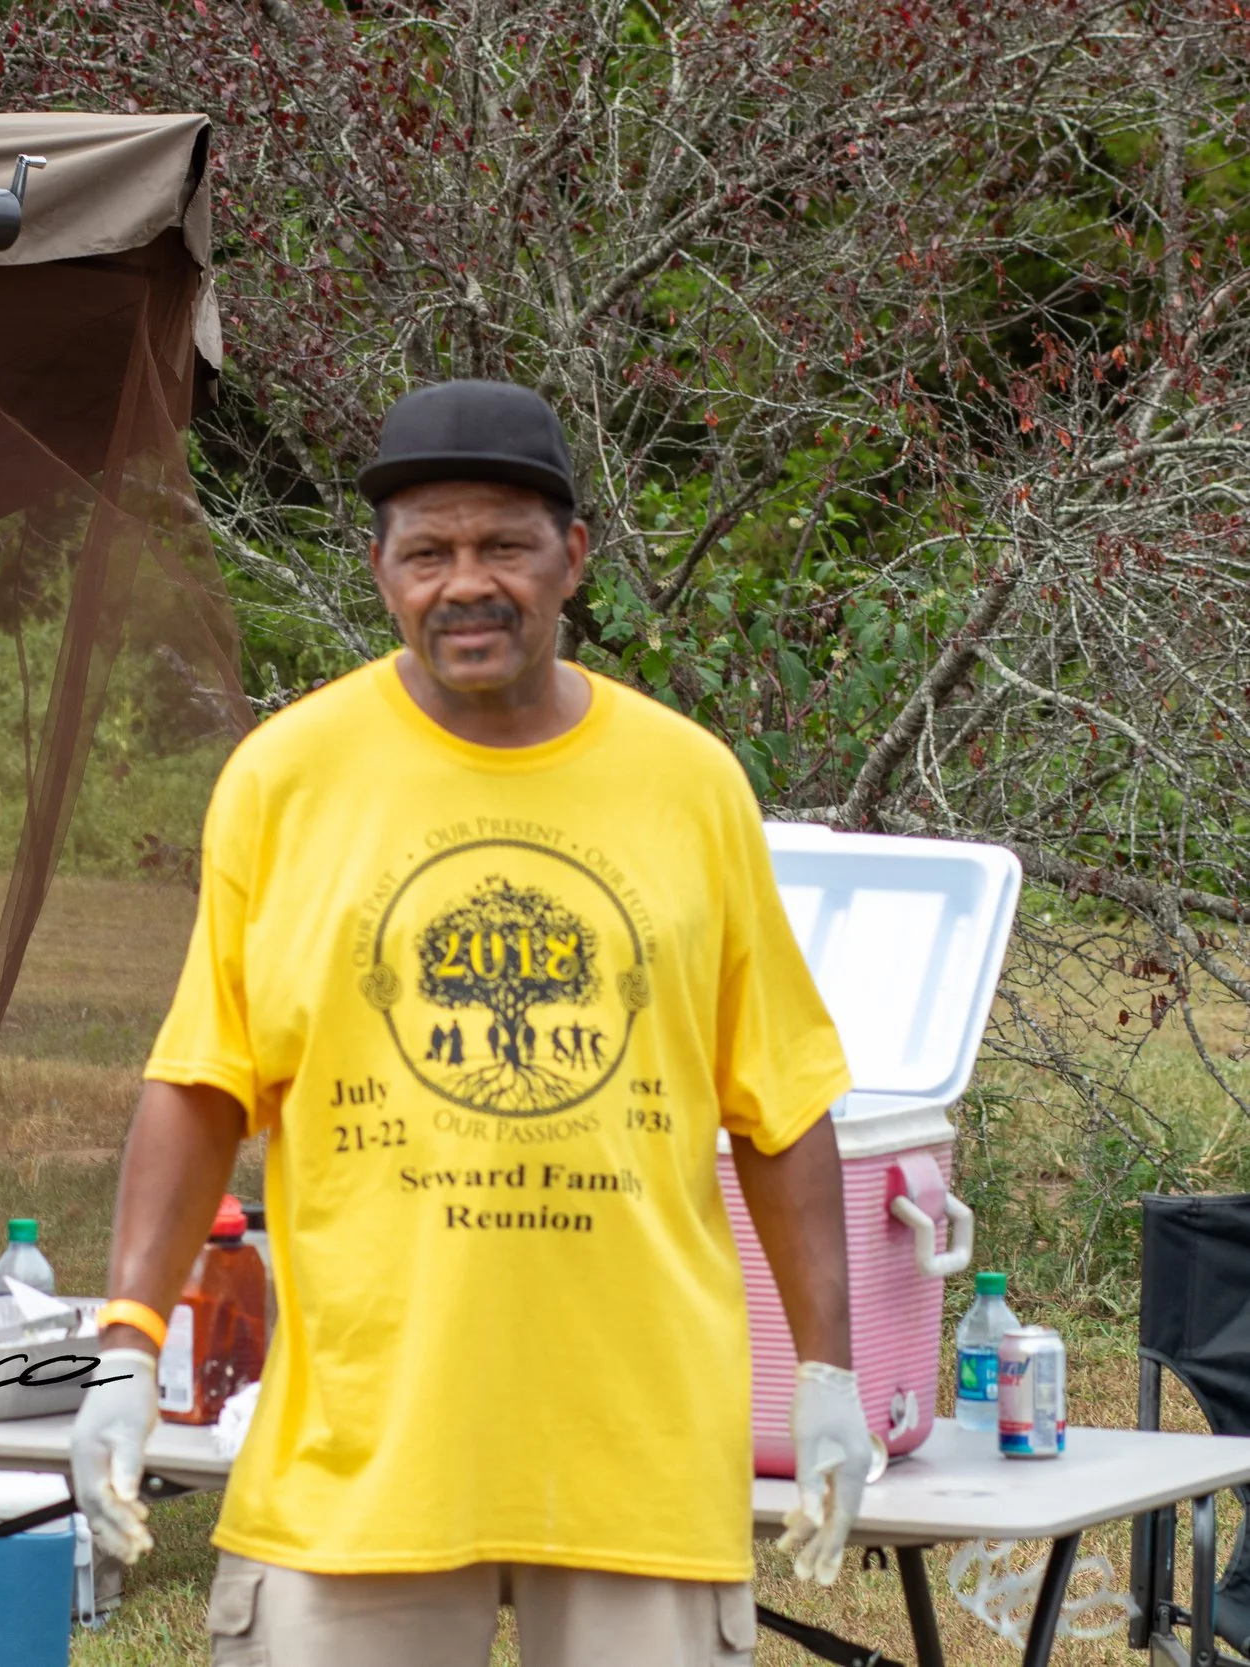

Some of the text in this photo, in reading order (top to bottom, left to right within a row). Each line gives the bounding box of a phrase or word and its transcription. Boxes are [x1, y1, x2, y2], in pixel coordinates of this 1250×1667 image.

[424, 815, 565, 850] OUR PRESENT
[584, 847, 626, 889] OUR
[350, 869, 398, 968] OUR PAST
[434, 928, 580, 981] 2018
[330, 1076, 390, 1111] July
[333, 1118, 408, 1153] 21-22
[433, 1108, 602, 1144] OUR PASSIONS
[399, 1164, 644, 1200] Seward Family
[444, 1204, 594, 1233] Reunion
